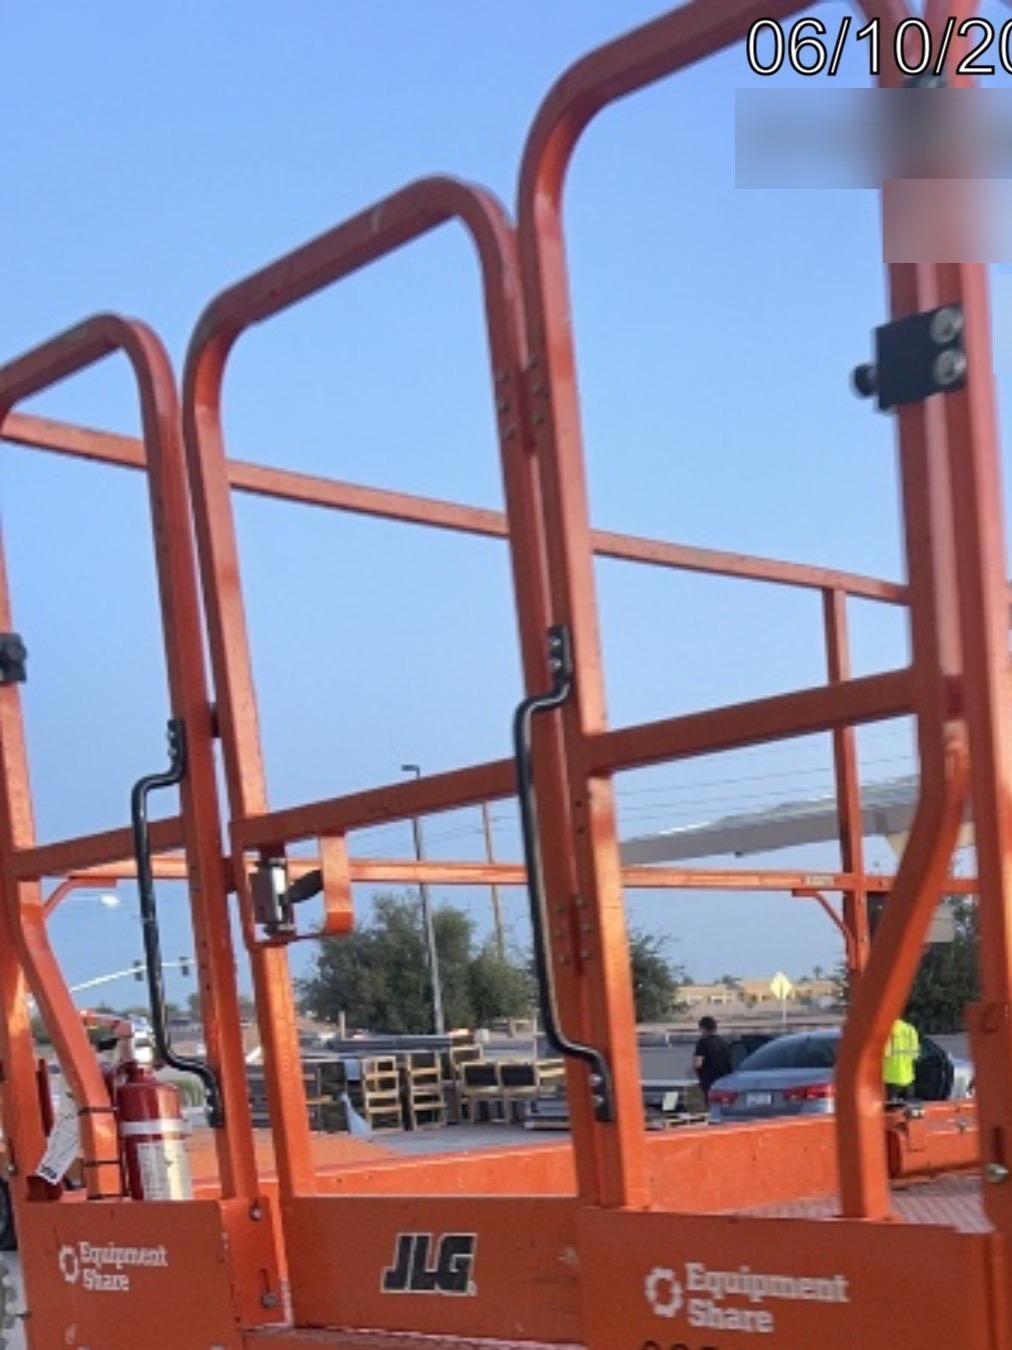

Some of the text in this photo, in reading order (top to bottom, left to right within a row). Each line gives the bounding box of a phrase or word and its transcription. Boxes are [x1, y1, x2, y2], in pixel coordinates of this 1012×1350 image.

[78, 1241, 168, 1270] Equipment
[380, 1231, 478, 1297] JLG
[82, 1268, 130, 1291] Share
[684, 1262, 850, 1303] Equipment
[686, 1298, 775, 1334] Share
